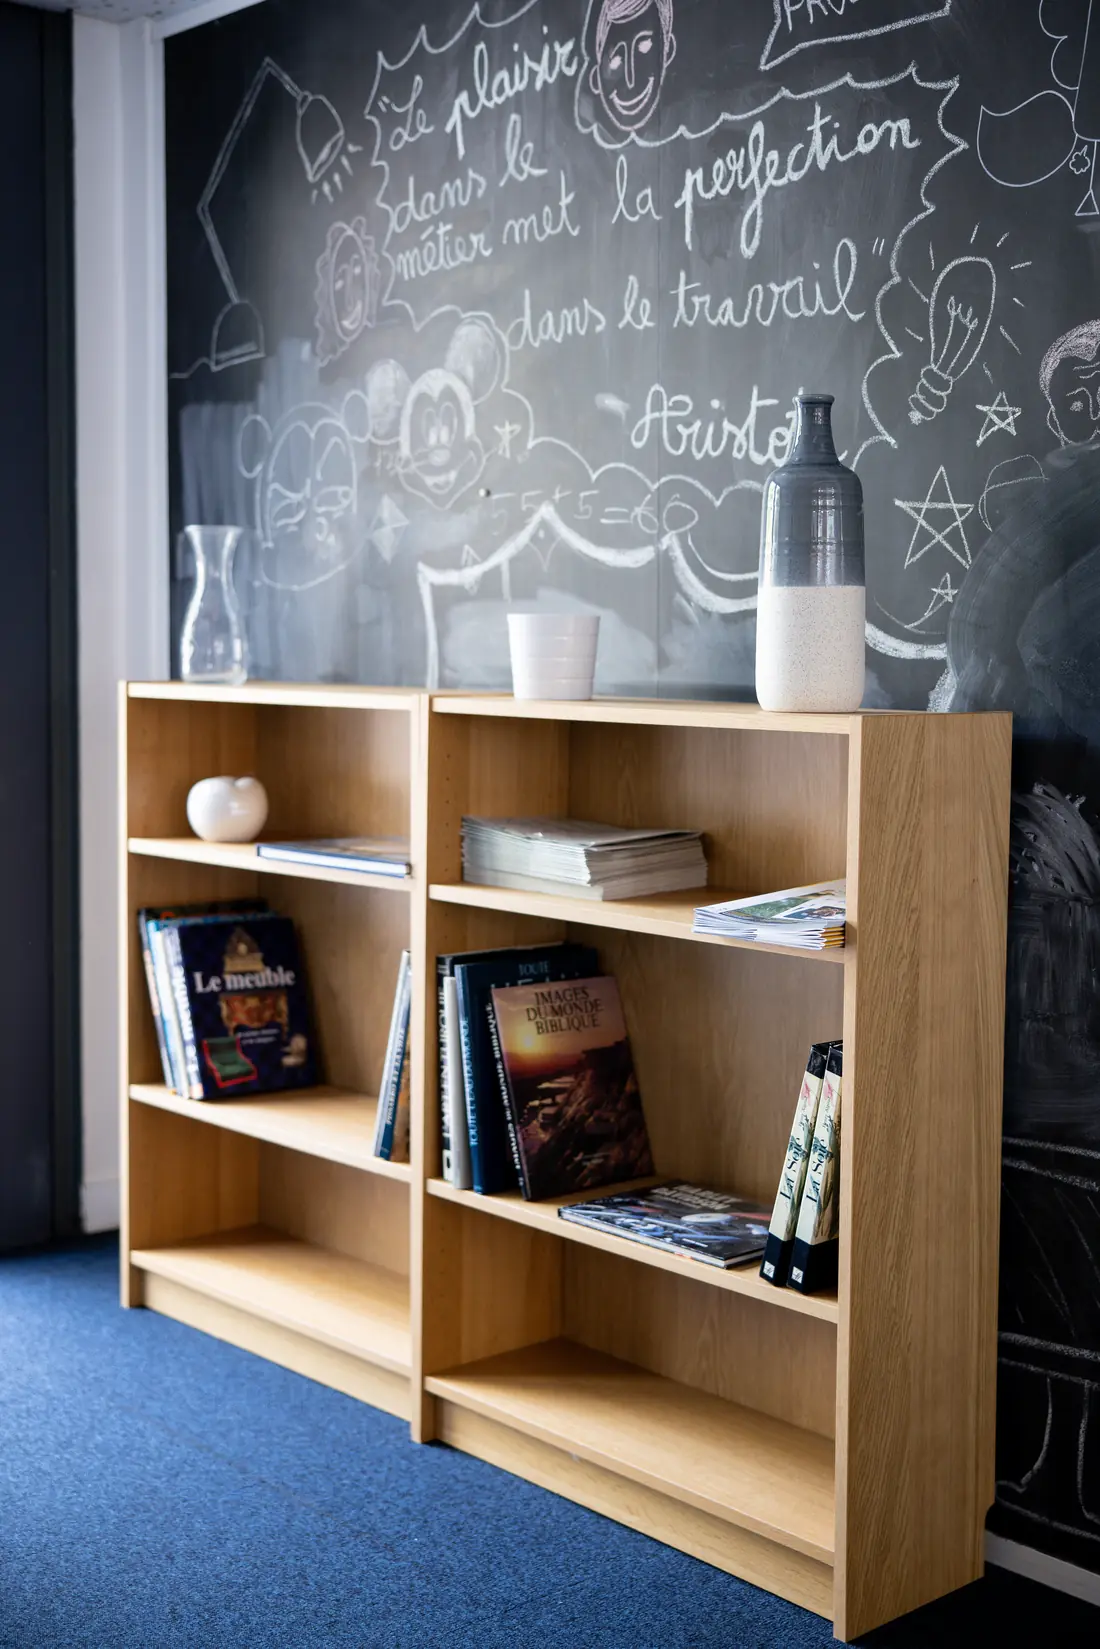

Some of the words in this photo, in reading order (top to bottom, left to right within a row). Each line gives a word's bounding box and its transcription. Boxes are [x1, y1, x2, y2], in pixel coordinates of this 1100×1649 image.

[444, 26, 579, 161] plaisir
[394, 167, 487, 233] dans
[499, 113, 548, 187] le
[398, 221, 493, 281] métier
[502, 169, 581, 244] met
[611, 155, 662, 223] la
[674, 101, 922, 259] perfection
[507, 289, 606, 350] dans
[617, 275, 655, 329] le
[193, 971, 222, 993] Le
[223, 964, 296, 990] meuble
[526, 1005, 547, 1022] DU
[548, 998, 604, 1018] MONDE
[534, 986, 590, 1005] IMAGES
[535, 1014, 600, 1035] BIBLIQUE
[468, 1111, 479, 1146] TOUTE
[780, 1177, 795, 1200] La
[806, 1181, 821, 1202] La
